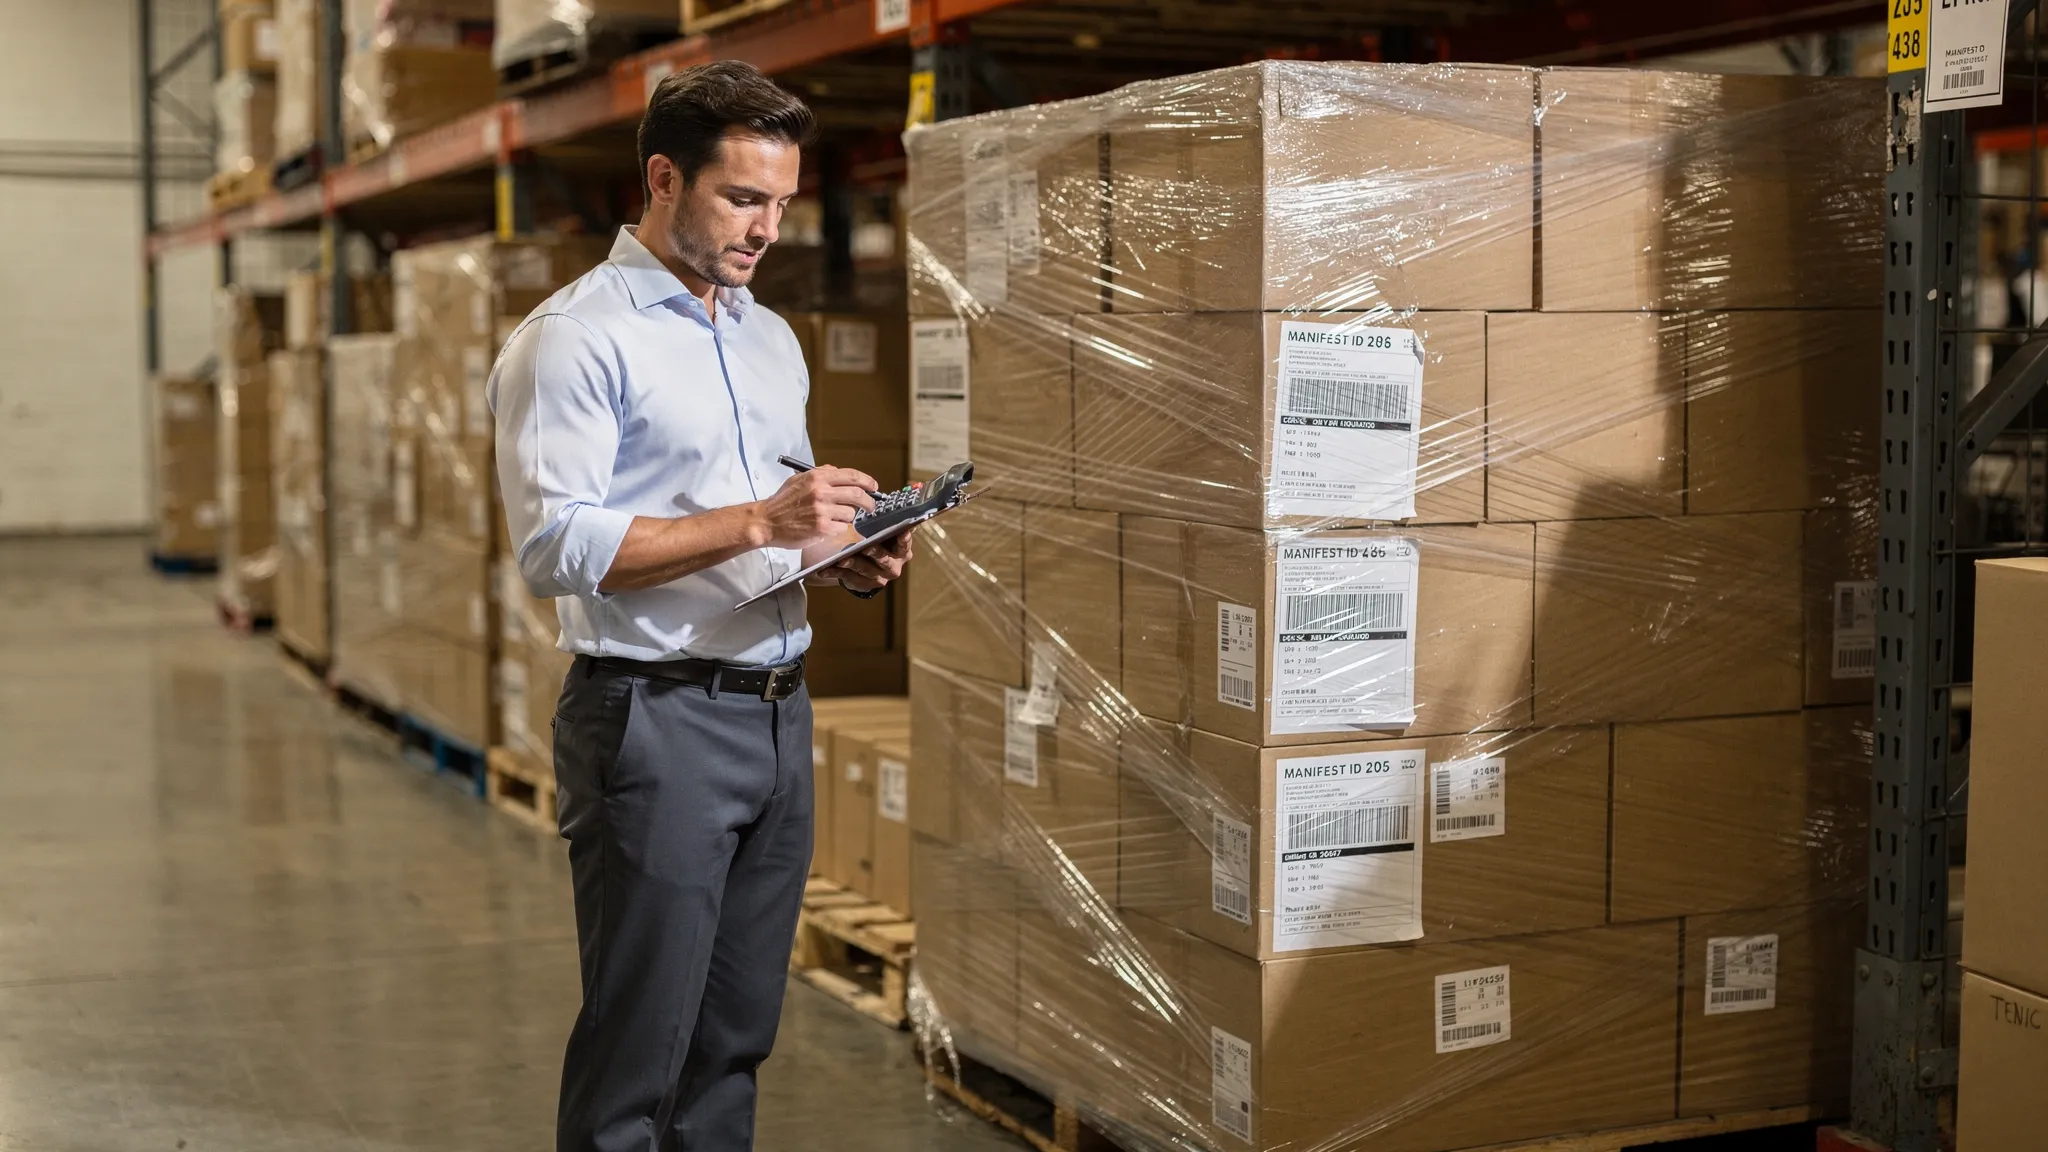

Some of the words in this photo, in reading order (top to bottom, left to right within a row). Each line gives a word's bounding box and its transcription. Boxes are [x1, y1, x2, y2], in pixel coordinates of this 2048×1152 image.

[1893, 29, 1920, 60] 438
[1288, 330, 1349, 346] MANIFEST
[1352, 335, 1364, 347] ID
[1284, 547, 1343, 559] MANIFEST
[1346, 547, 1358, 558] ID
[1284, 764, 1346, 779] MANIFEST
[1350, 763, 1362, 774] ID
[1366, 760, 1390, 774] 205
[1989, 994, 2041, 1030] TENIC
